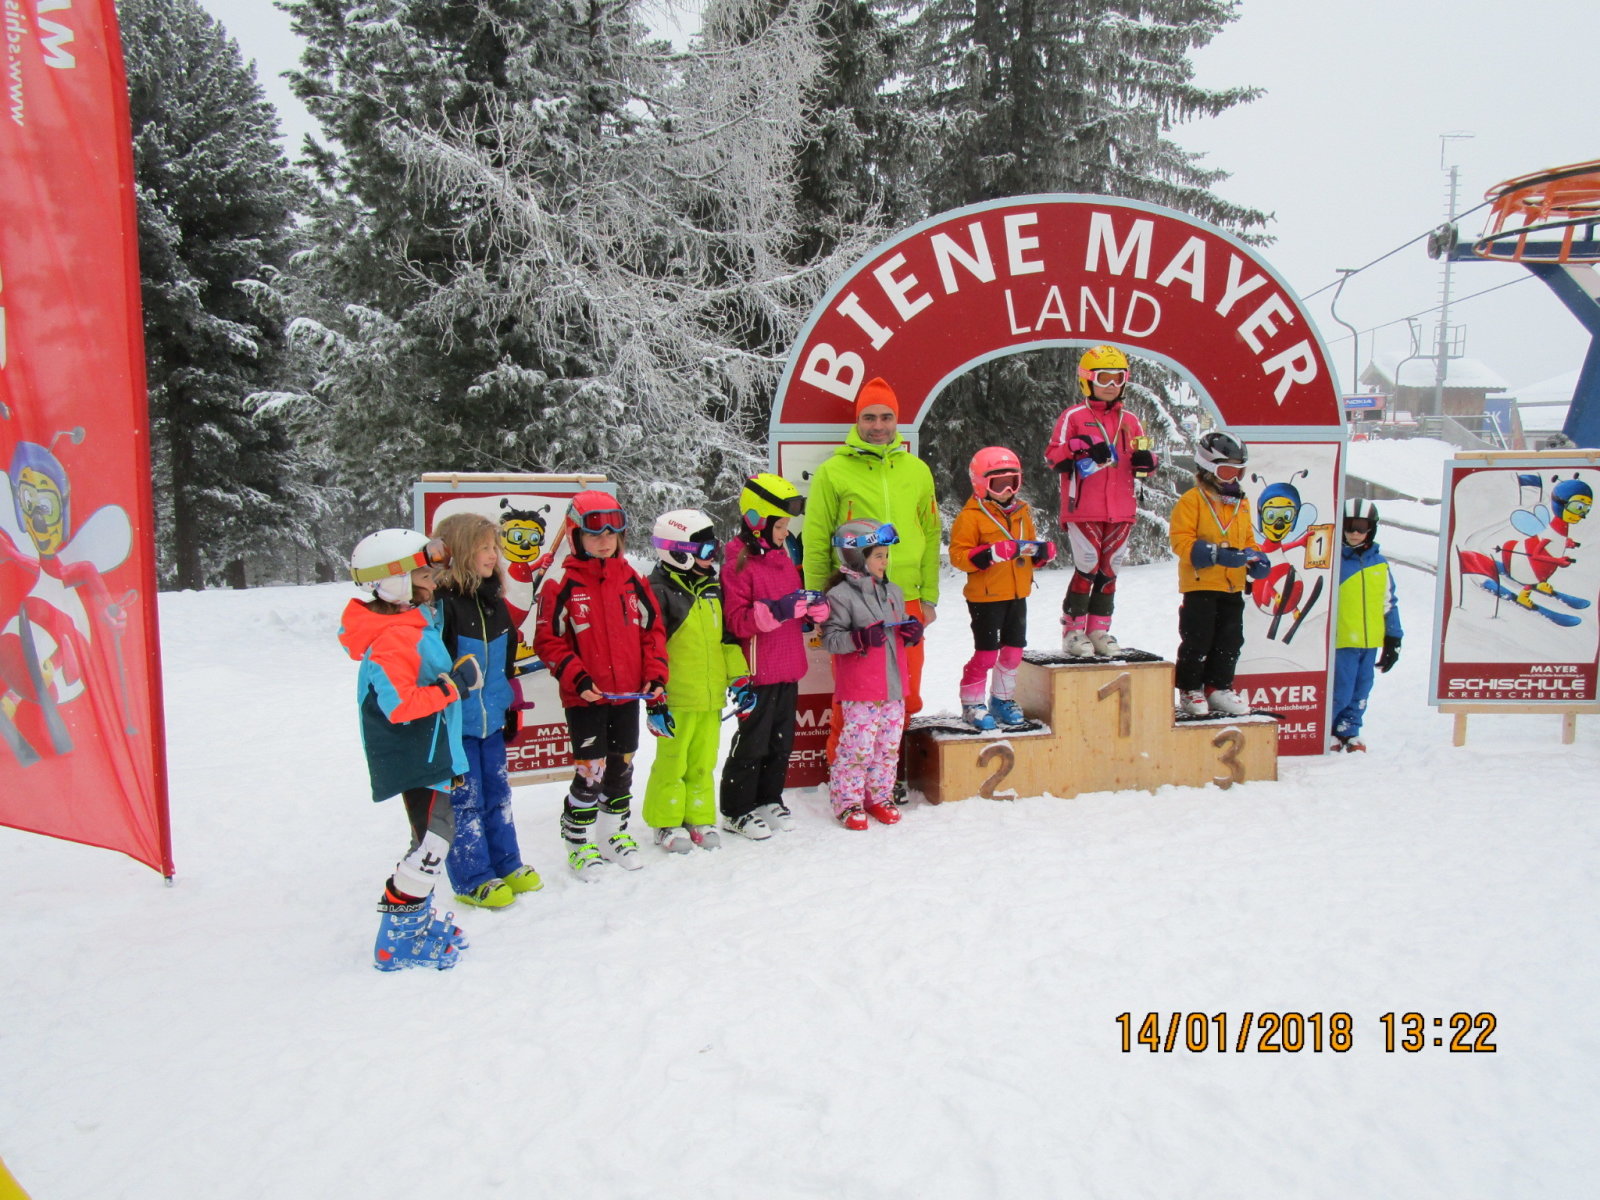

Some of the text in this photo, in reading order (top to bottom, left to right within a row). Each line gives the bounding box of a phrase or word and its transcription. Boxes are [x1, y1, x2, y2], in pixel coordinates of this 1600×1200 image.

[799, 211, 1318, 407] BIENE MAYER
[1004, 285, 1162, 338] LAND
[668, 519, 688, 533] uvex
[1316, 536, 1323, 556] 1
[1448, 678, 1586, 690] SCHISCHULE
[1530, 665, 1578, 673] MAYER
[1097, 672, 1132, 738] 1
[1447, 691, 1586, 699] KREISCHBERG
[976, 741, 1015, 800] 2
[1212, 727, 1246, 790] 3
